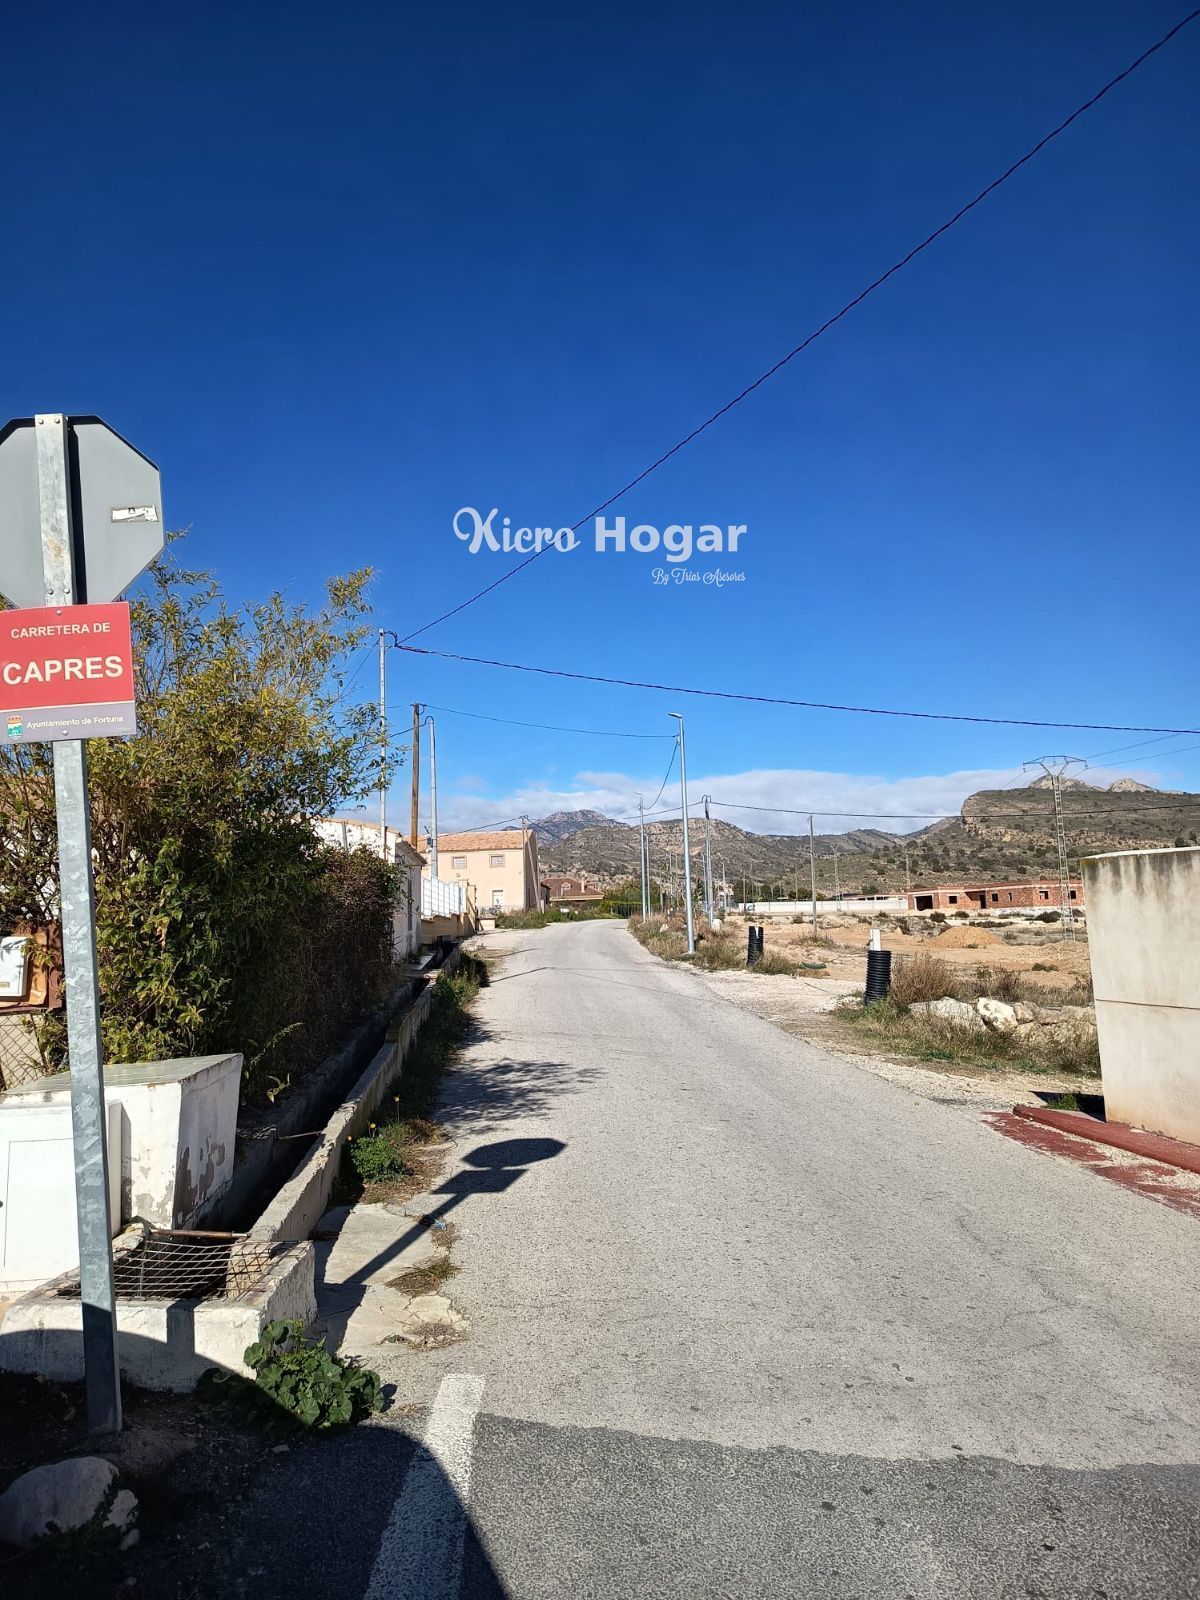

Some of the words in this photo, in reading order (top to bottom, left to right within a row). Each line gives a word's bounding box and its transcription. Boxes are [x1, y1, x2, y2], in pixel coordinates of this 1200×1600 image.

[10, 623, 90, 639] CARRETERA
[93, 621, 111, 633] DE
[2, 655, 123, 686] CAPRES
[26, 719, 80, 730] Ayuntamiento
[81, 717, 92, 725] de
[93, 715, 124, 724] Fortuna
